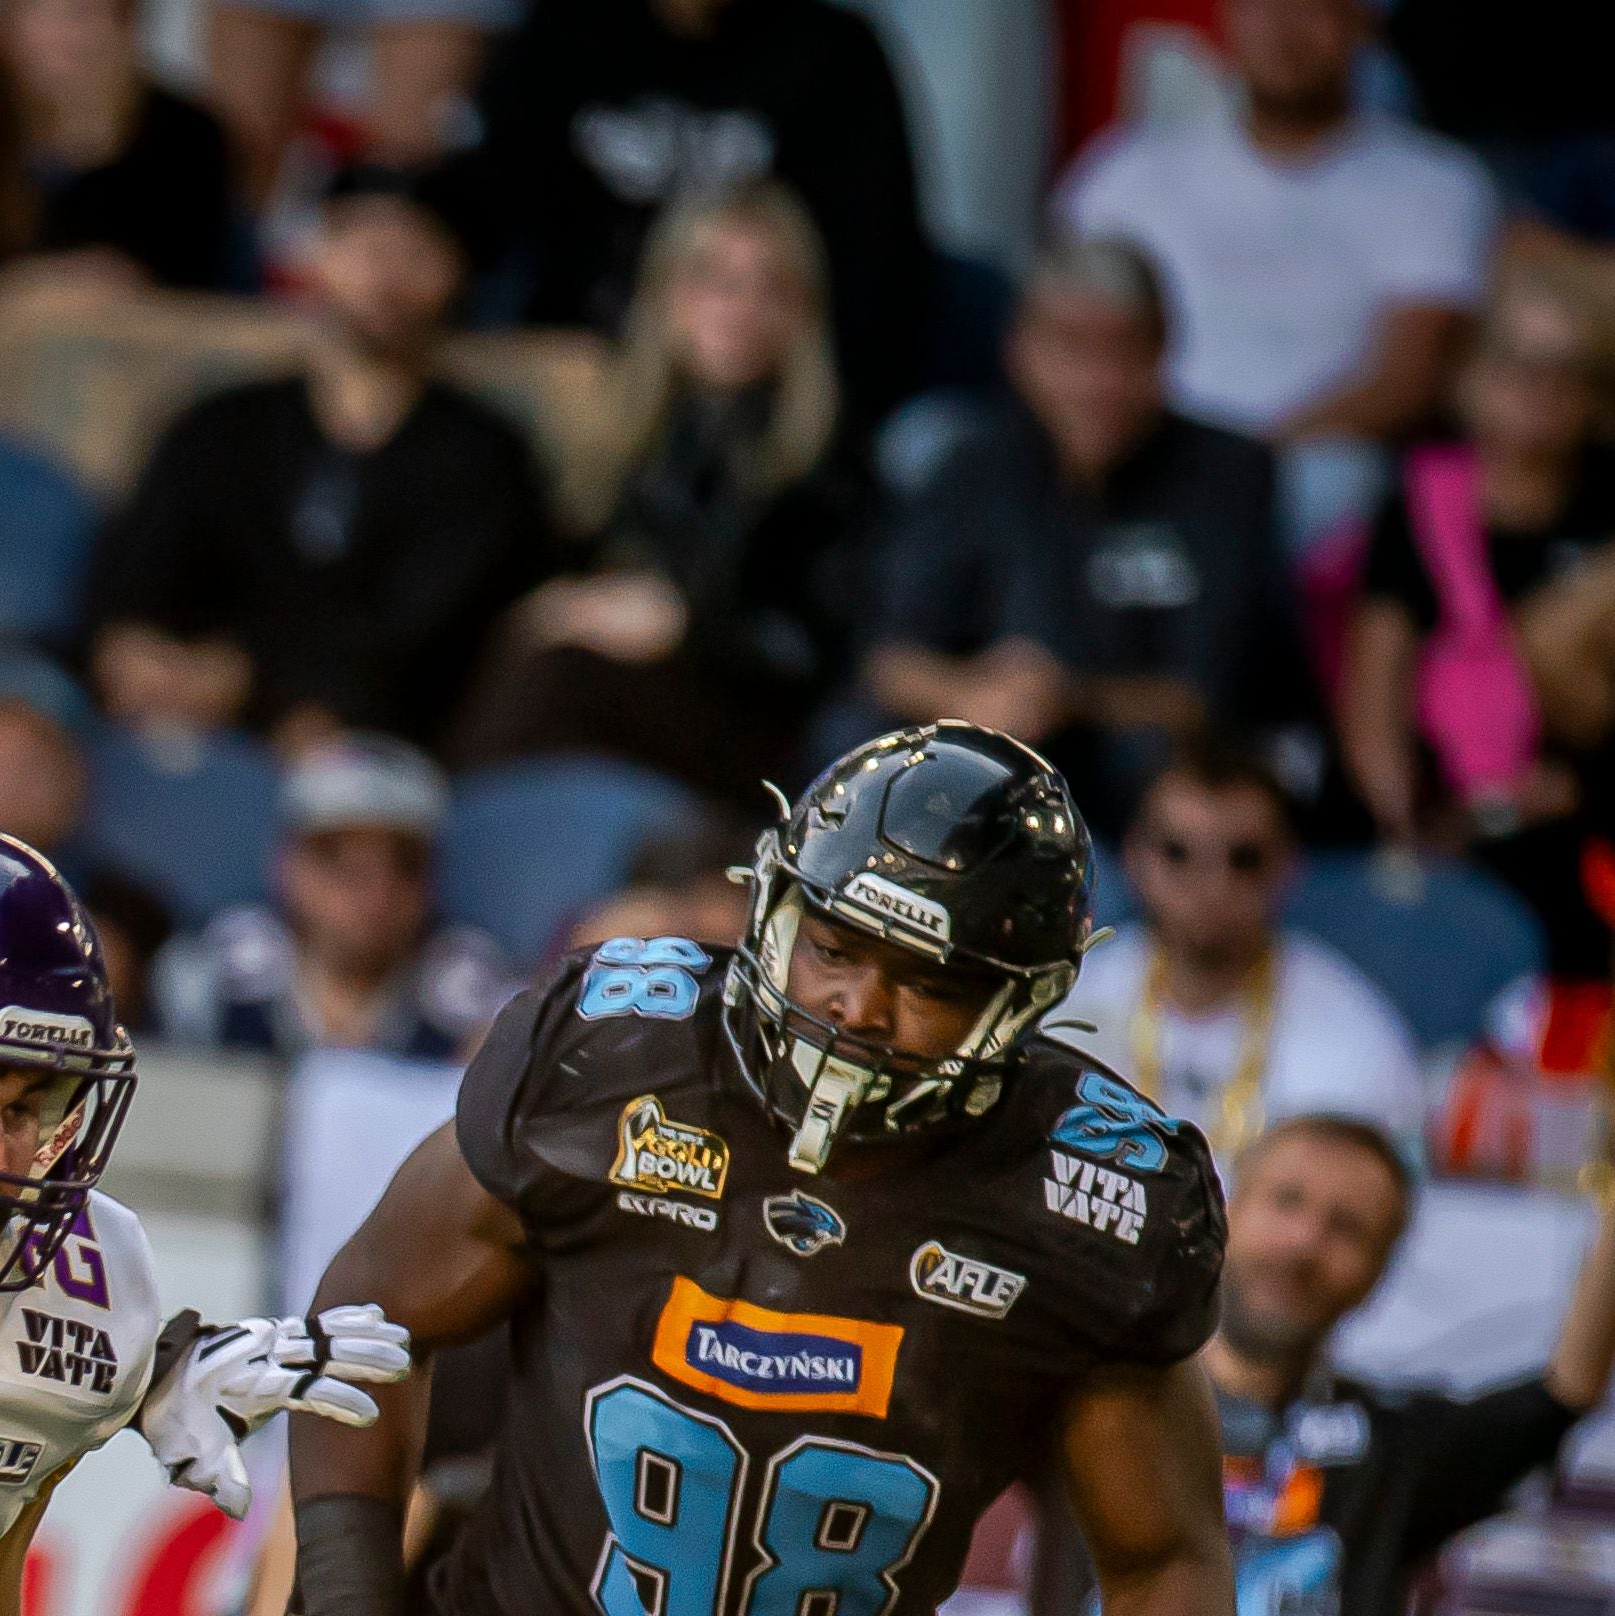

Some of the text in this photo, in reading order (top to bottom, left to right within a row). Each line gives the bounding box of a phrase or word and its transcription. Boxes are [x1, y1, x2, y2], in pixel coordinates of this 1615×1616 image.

[637, 1150, 716, 1191] BOWL
[1050, 1150, 1147, 1216] VITA
[1042, 1177, 1146, 1245] VATE
[925, 1254, 1018, 1307] AFLE
[20, 1307, 118, 1363] VITA
[697, 1326, 855, 1384] TARCZYŃSKI
[16, 1340, 118, 1395] VATE
